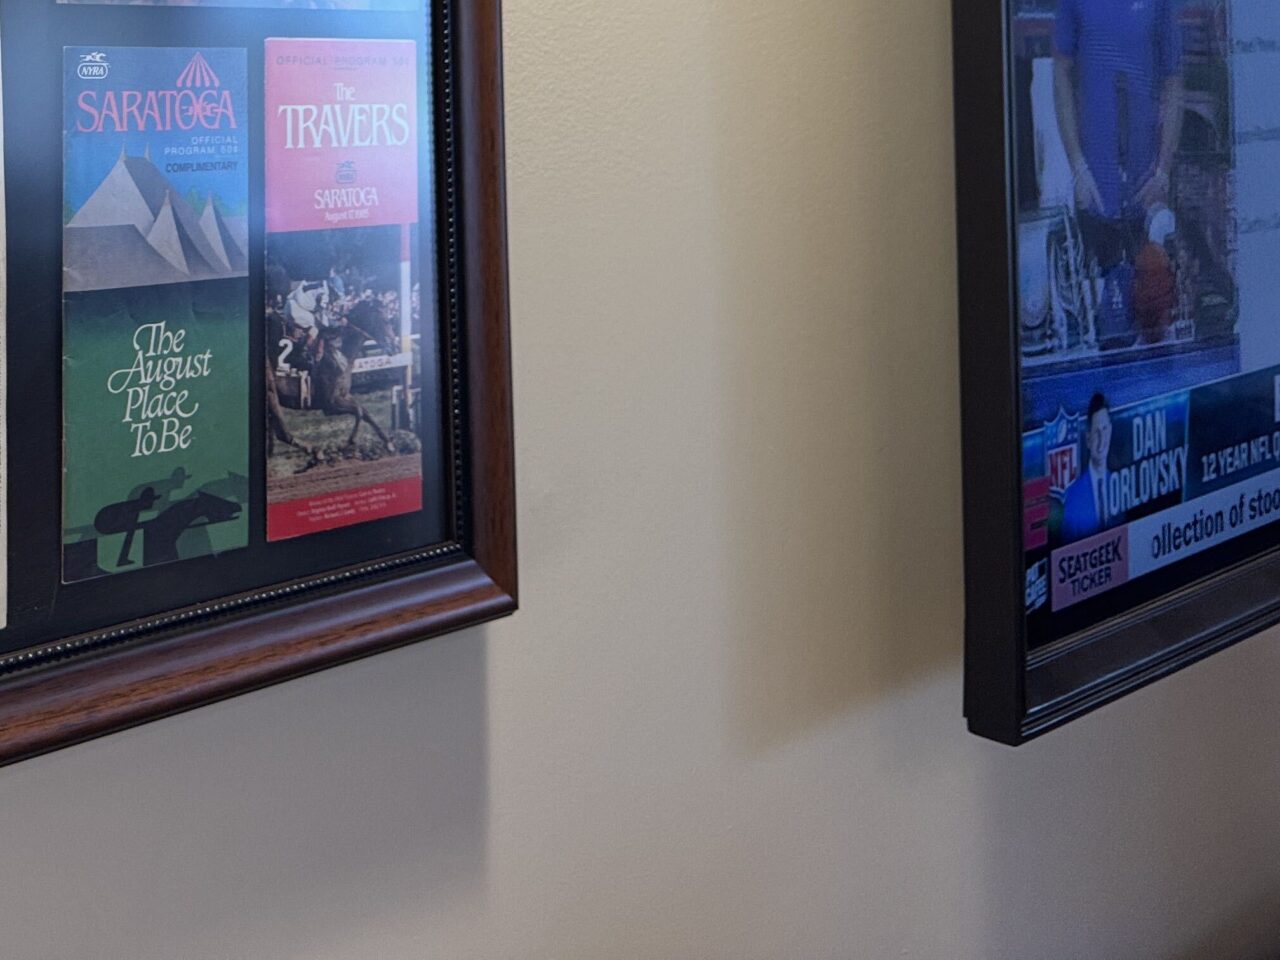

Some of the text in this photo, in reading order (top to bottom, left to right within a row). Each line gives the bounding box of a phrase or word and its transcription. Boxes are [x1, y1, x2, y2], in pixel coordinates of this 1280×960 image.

[81, 65, 104, 76] NYRA
[334, 82, 356, 101] The
[76, 89, 237, 133] SARATOGA
[277, 103, 410, 149] TRAVERS
[164, 146, 215, 155] PROGRAM
[191, 135, 239, 145] OFFICIAL
[165, 161, 238, 173] COMPLIMENTARY
[313, 187, 379, 209] SARATOGA
[132, 320, 186, 357] The
[276, 338, 293, 369] 2
[107, 349, 213, 393] August
[122, 385, 199, 422] Place
[130, 417, 193, 458] To Be
[1132, 408, 1167, 461] DAN
[1048, 443, 1078, 490] NFL
[1201, 452, 1217, 483] 12
[1219, 441, 1249, 476] YEAR
[1250, 434, 1271, 465] NFL
[1109, 443, 1189, 516] ORLOVSKY
[1229, 493, 1245, 528] of
[1058, 536, 1123, 584] SEATGEEK
[1070, 566, 1112, 597] TICKER
